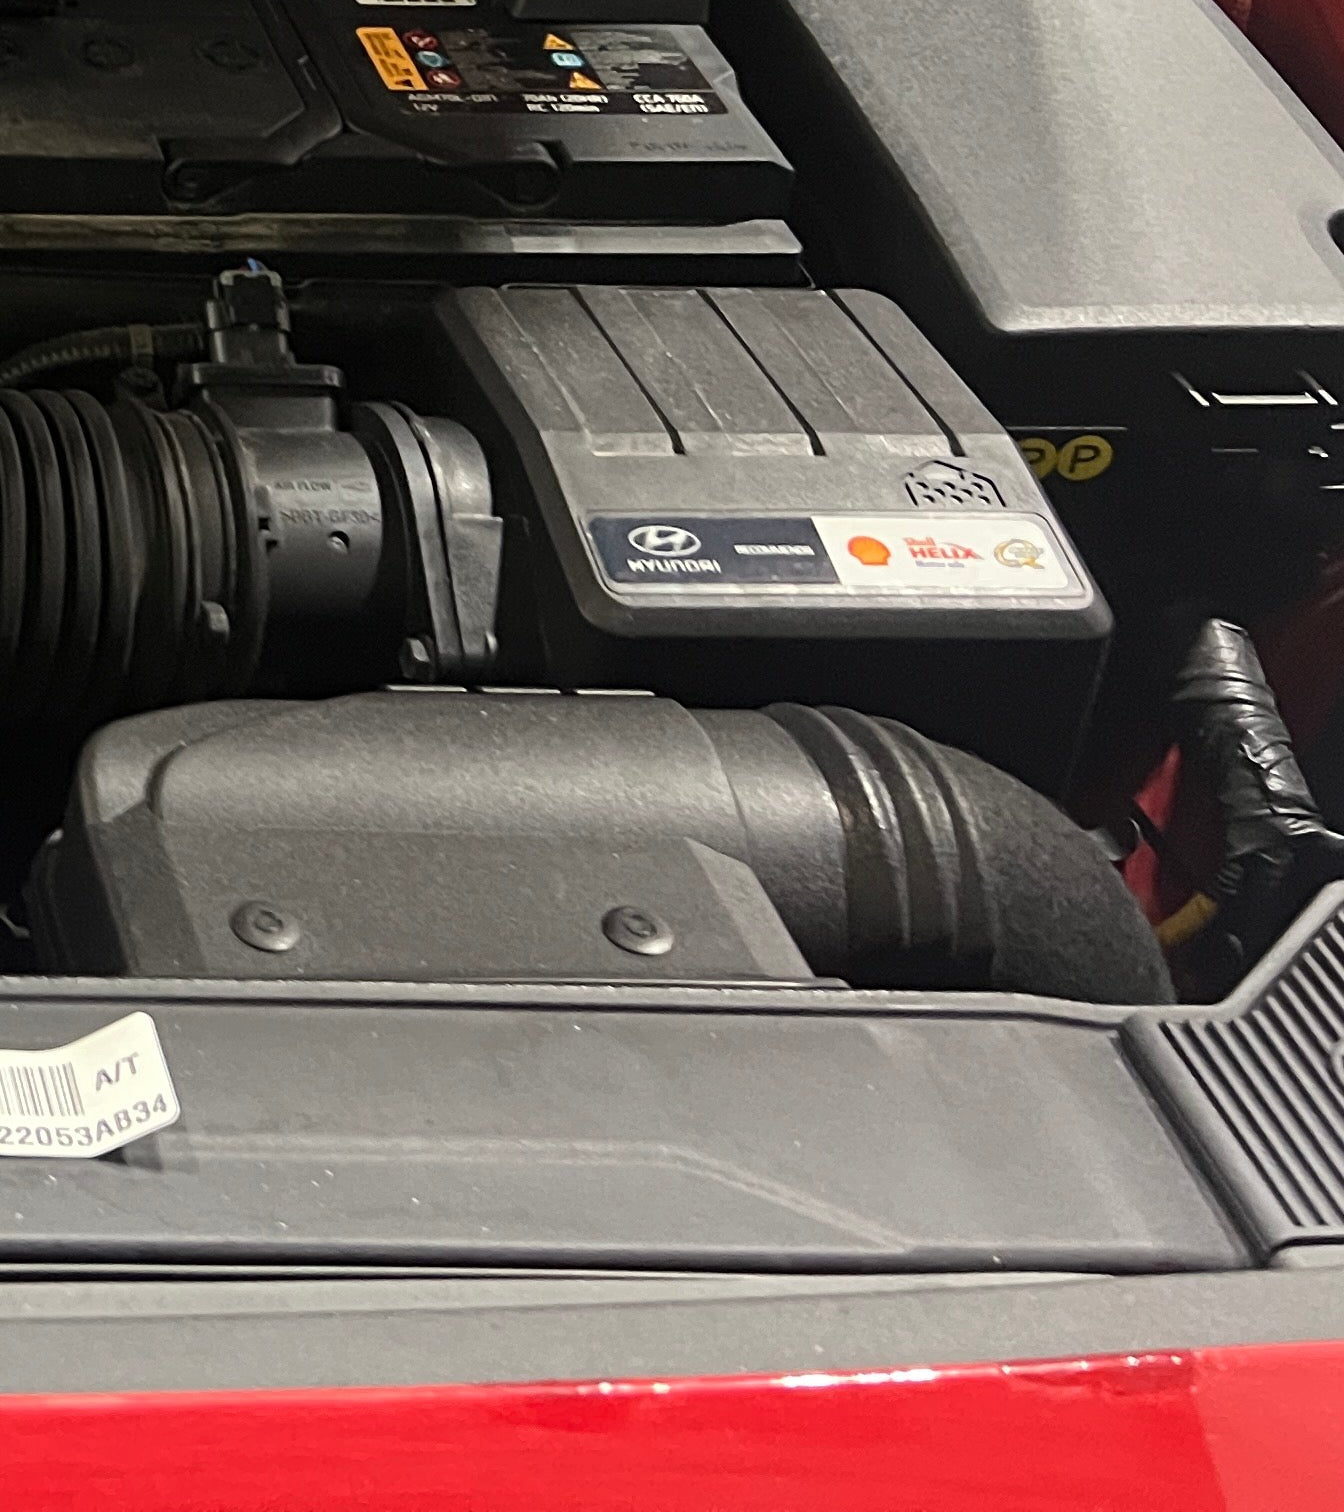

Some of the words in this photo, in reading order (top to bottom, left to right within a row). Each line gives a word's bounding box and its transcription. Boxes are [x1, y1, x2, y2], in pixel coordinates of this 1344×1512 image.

[632, 93, 665, 104] CCA
[1068, 444, 1102, 474] P
[909, 546, 981, 560] HELIX
[626, 558, 722, 573] HYUNDAI
[95, 1051, 140, 1092] A/T
